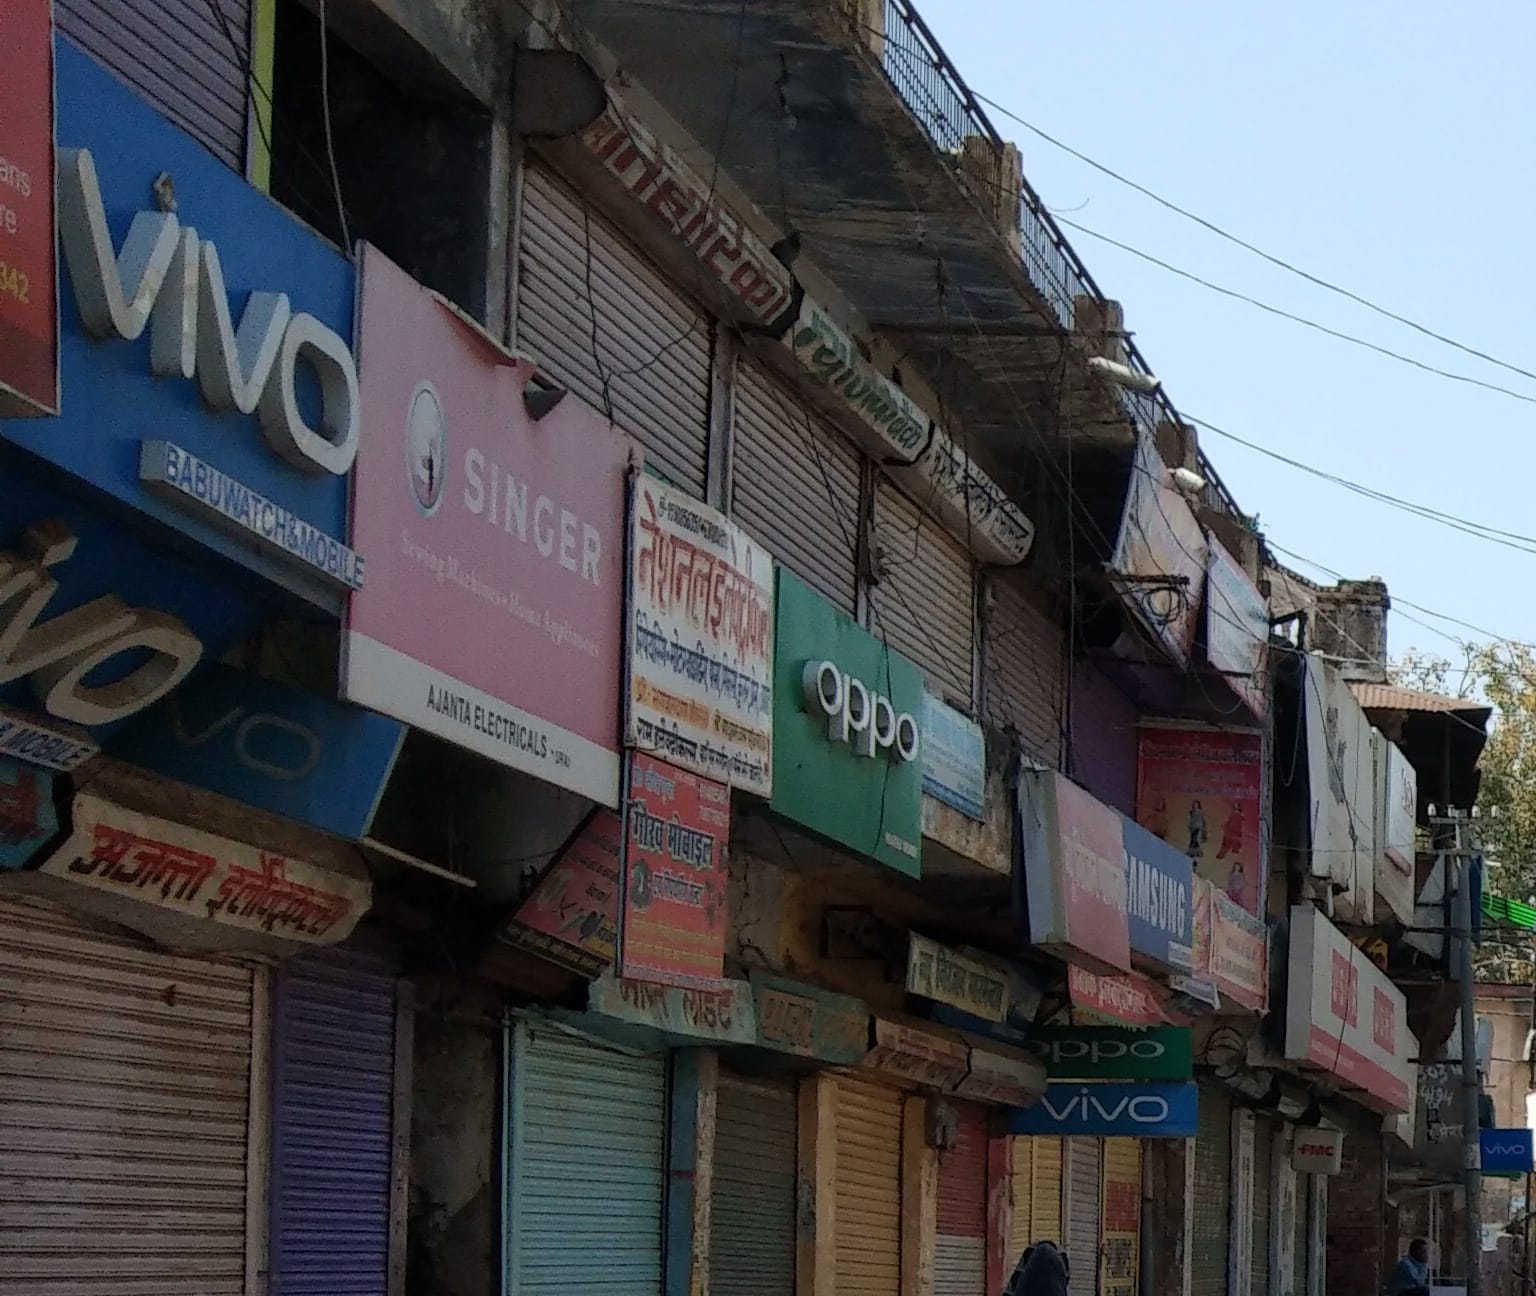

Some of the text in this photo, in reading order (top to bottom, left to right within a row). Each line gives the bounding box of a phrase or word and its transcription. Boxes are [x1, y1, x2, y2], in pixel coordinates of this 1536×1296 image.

[464, 447, 601, 587] SINGER
[427, 683, 472, 723] AJANTA
[473, 704, 548, 761] ELECTRICALS
[806, 659, 920, 764] oppo
[1040, 1086, 1169, 1123] vivo
[1483, 1143, 1527, 1157] vivo
